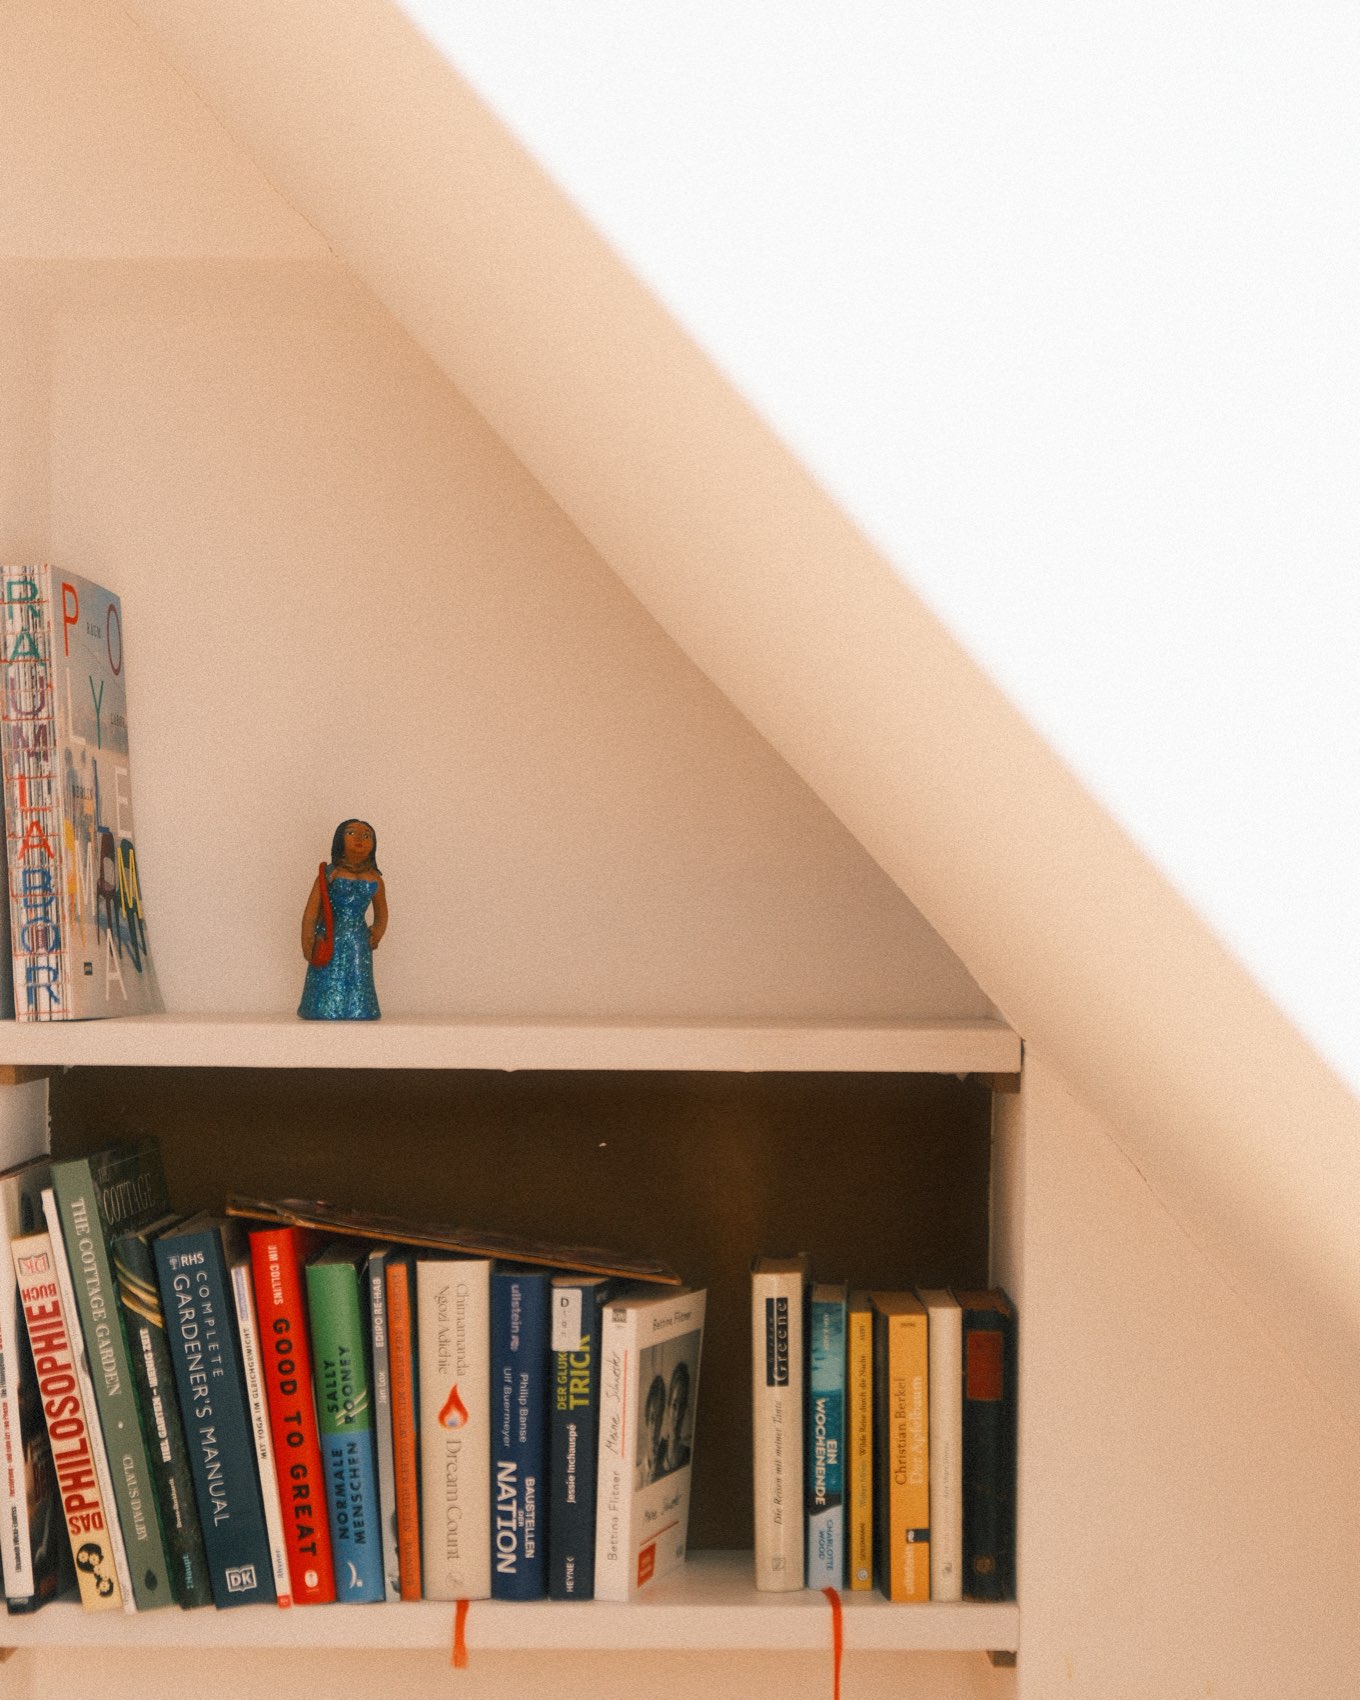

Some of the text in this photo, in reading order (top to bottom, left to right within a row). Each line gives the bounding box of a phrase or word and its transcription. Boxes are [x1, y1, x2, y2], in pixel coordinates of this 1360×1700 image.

[21, 1284, 57, 1302] BUCH
[180, 1253, 205, 1267] RHS
[267, 1246, 284, 1305] JIM COLLINS
[71, 1198, 120, 1397] THE COTTAGE GARDEN
[195, 1271, 224, 1378] COMPLETE
[374, 1317, 384, 1347] EDIPO
[434, 1286, 451, 1374] Ngozi Adichie
[455, 1283, 469, 1375] Chimamanda
[510, 1284, 521, 1333] ullstein
[139, 1329, 151, 1351] ZEIT
[143, 1352, 158, 1387] WENIG
[557, 1349, 567, 1383] GLUK
[772, 1302, 787, 1380] Greene
[27, 1302, 97, 1514] PHILOSOPHIE
[152, 1396, 167, 1438] GARTEN
[173, 1274, 229, 1526] GARDENER'S MANUAL
[242, 1329, 267, 1459] MIT YOGA IM GLEICHGEWICHT
[323, 1359, 339, 1414] SALLY
[338, 1346, 357, 1424] ROONEY
[501, 1368, 511, 1446] Ulf Buermeyer
[518, 1373, 528, 1442] Philip Banse
[556, 1387, 567, 1410] DER
[160, 1438, 171, 1463] VIEL
[272, 1318, 317, 1557] GOOD TO GREAT
[566, 1424, 578, 1502] Jessie Inchauspé
[774, 1428, 782, 1456] meiner
[814, 1398, 826, 1505] WOCHENENDE
[826, 1439, 837, 1465] EIN
[894, 1378, 906, 1484] Christian Berkel
[122, 1455, 147, 1541] CLAUS DALBY
[331, 1450, 349, 1539] NORMALE
[347, 1443, 365, 1544] MENSCHEN
[445, 1440, 462, 1560] Dream Count
[773, 1478, 782, 1505] Reisen
[774, 1460, 782, 1474] mit
[68, 1512, 104, 1535] DAS
[496, 1462, 517, 1573] NATION
[524, 1478, 535, 1558] BAUSTELLEN
[606, 1471, 620, 1560] Bettina Flitner
[773, 1508, 782, 1524] Die
[825, 1519, 834, 1570] CHARLOTTE
[229, 1570, 253, 1588] DK
[565, 1563, 574, 1592] HEYNE
